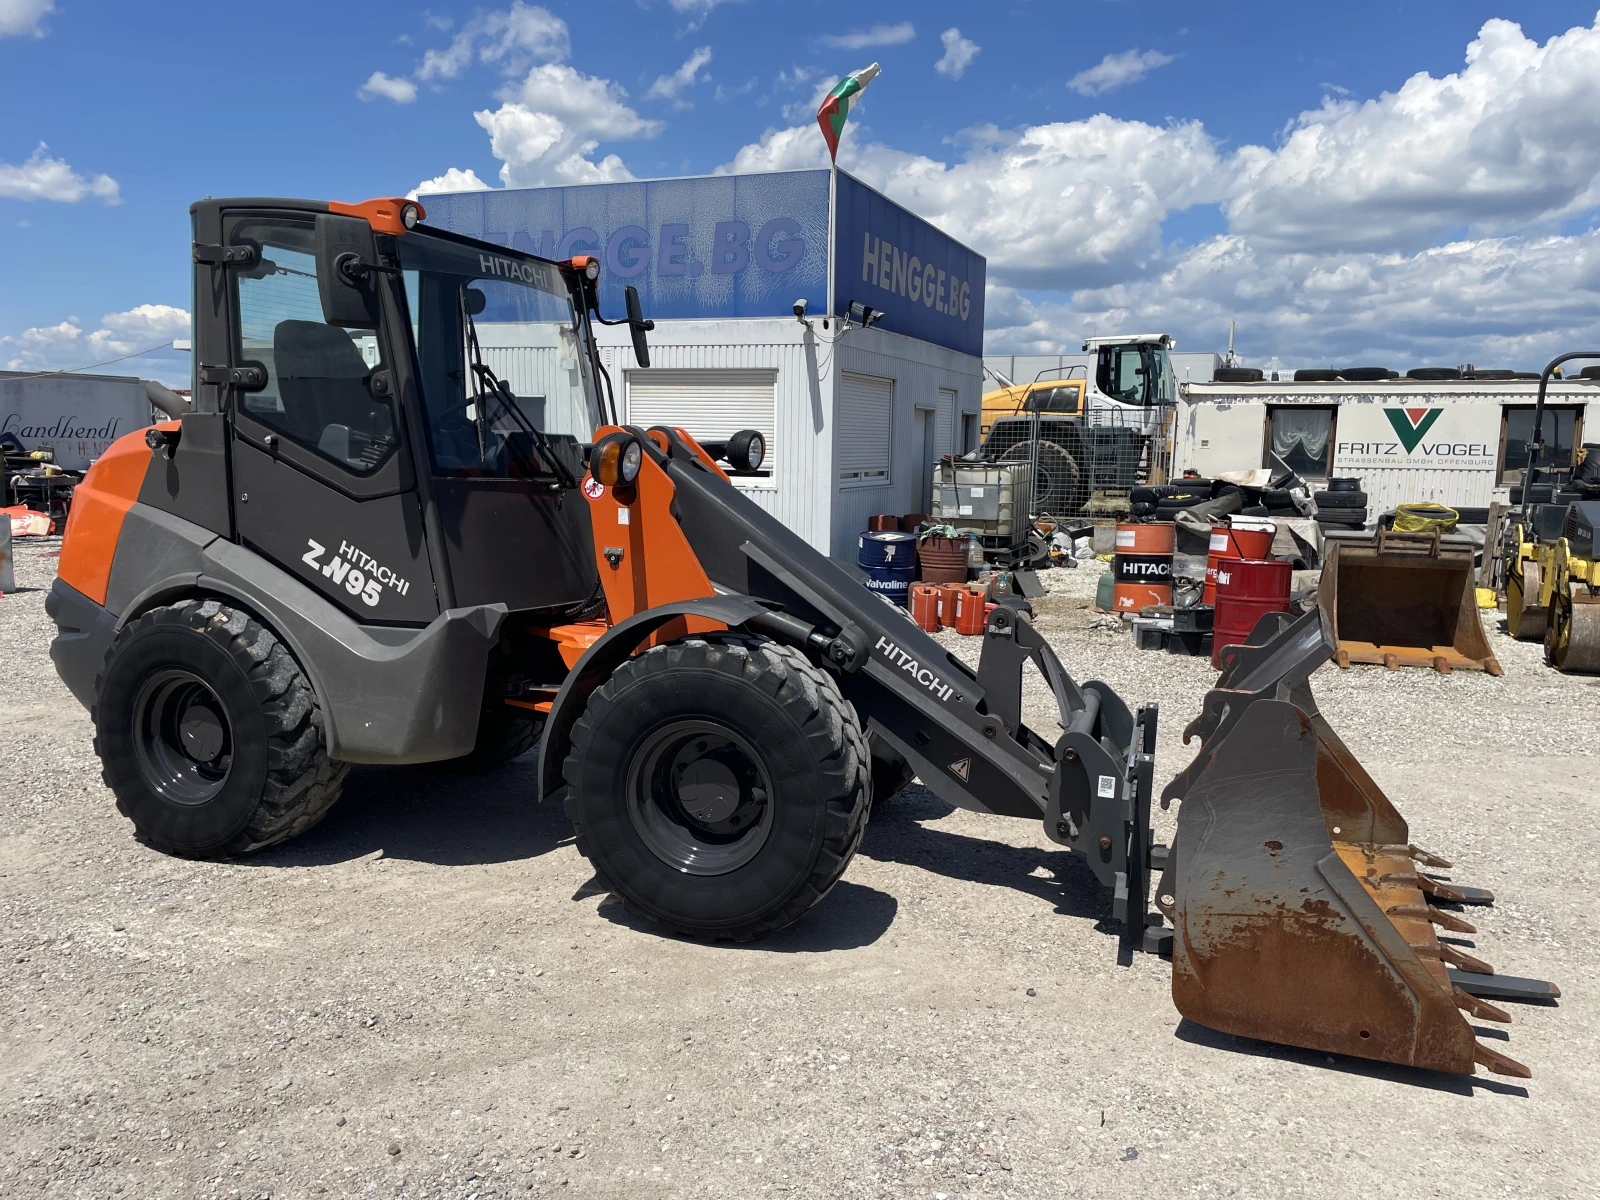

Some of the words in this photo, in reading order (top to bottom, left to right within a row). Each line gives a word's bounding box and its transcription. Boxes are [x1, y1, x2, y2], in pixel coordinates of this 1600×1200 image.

[478, 254, 549, 289] HITACHI
[862, 231, 971, 321] HENGGE.BG
[1338, 442, 1398, 455] FRITZ
[1421, 443, 1494, 457] VOGEL
[338, 539, 410, 596] HITACHI
[866, 578, 909, 590] Valvoline
[875, 635, 954, 702] HITACHI
